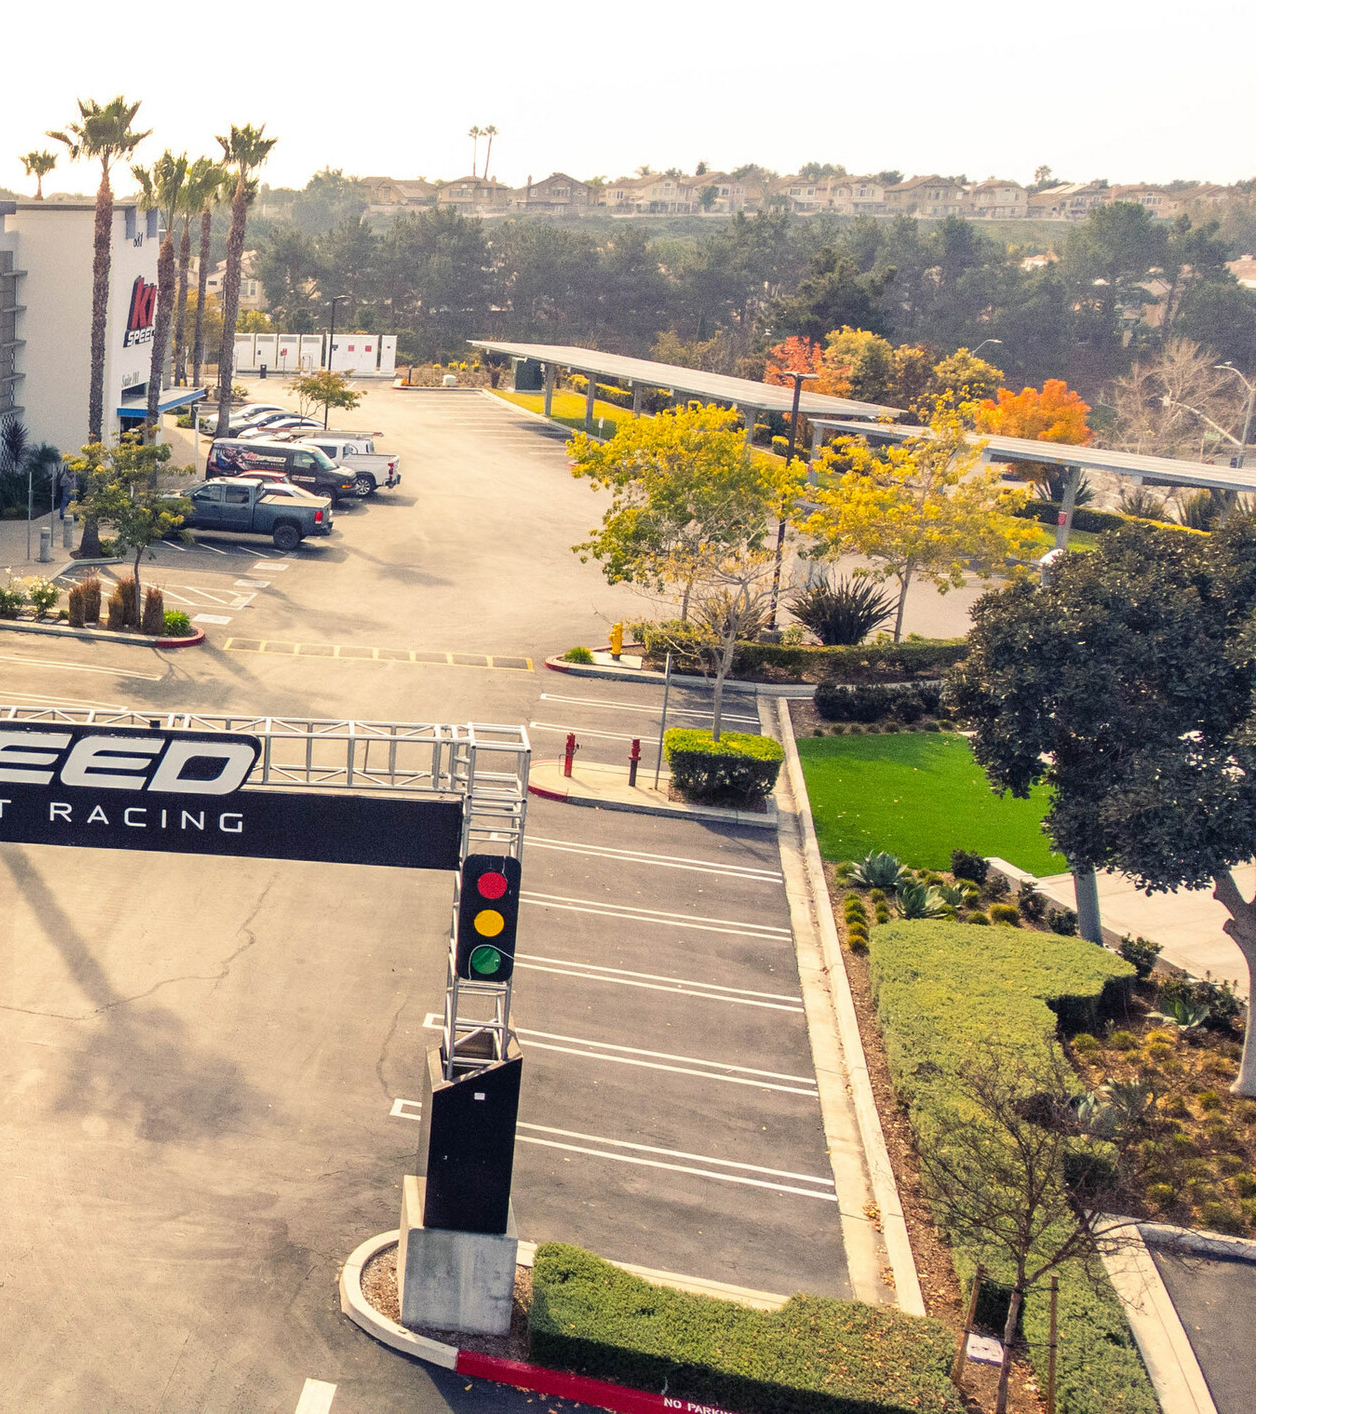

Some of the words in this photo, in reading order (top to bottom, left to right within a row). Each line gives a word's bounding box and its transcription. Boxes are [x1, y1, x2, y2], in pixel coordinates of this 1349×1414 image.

[131, 277, 157, 331] K1
[50, 801, 243, 833] RACING
[663, 1397, 682, 1409] NO
[687, 1402, 733, 1414] PARK
